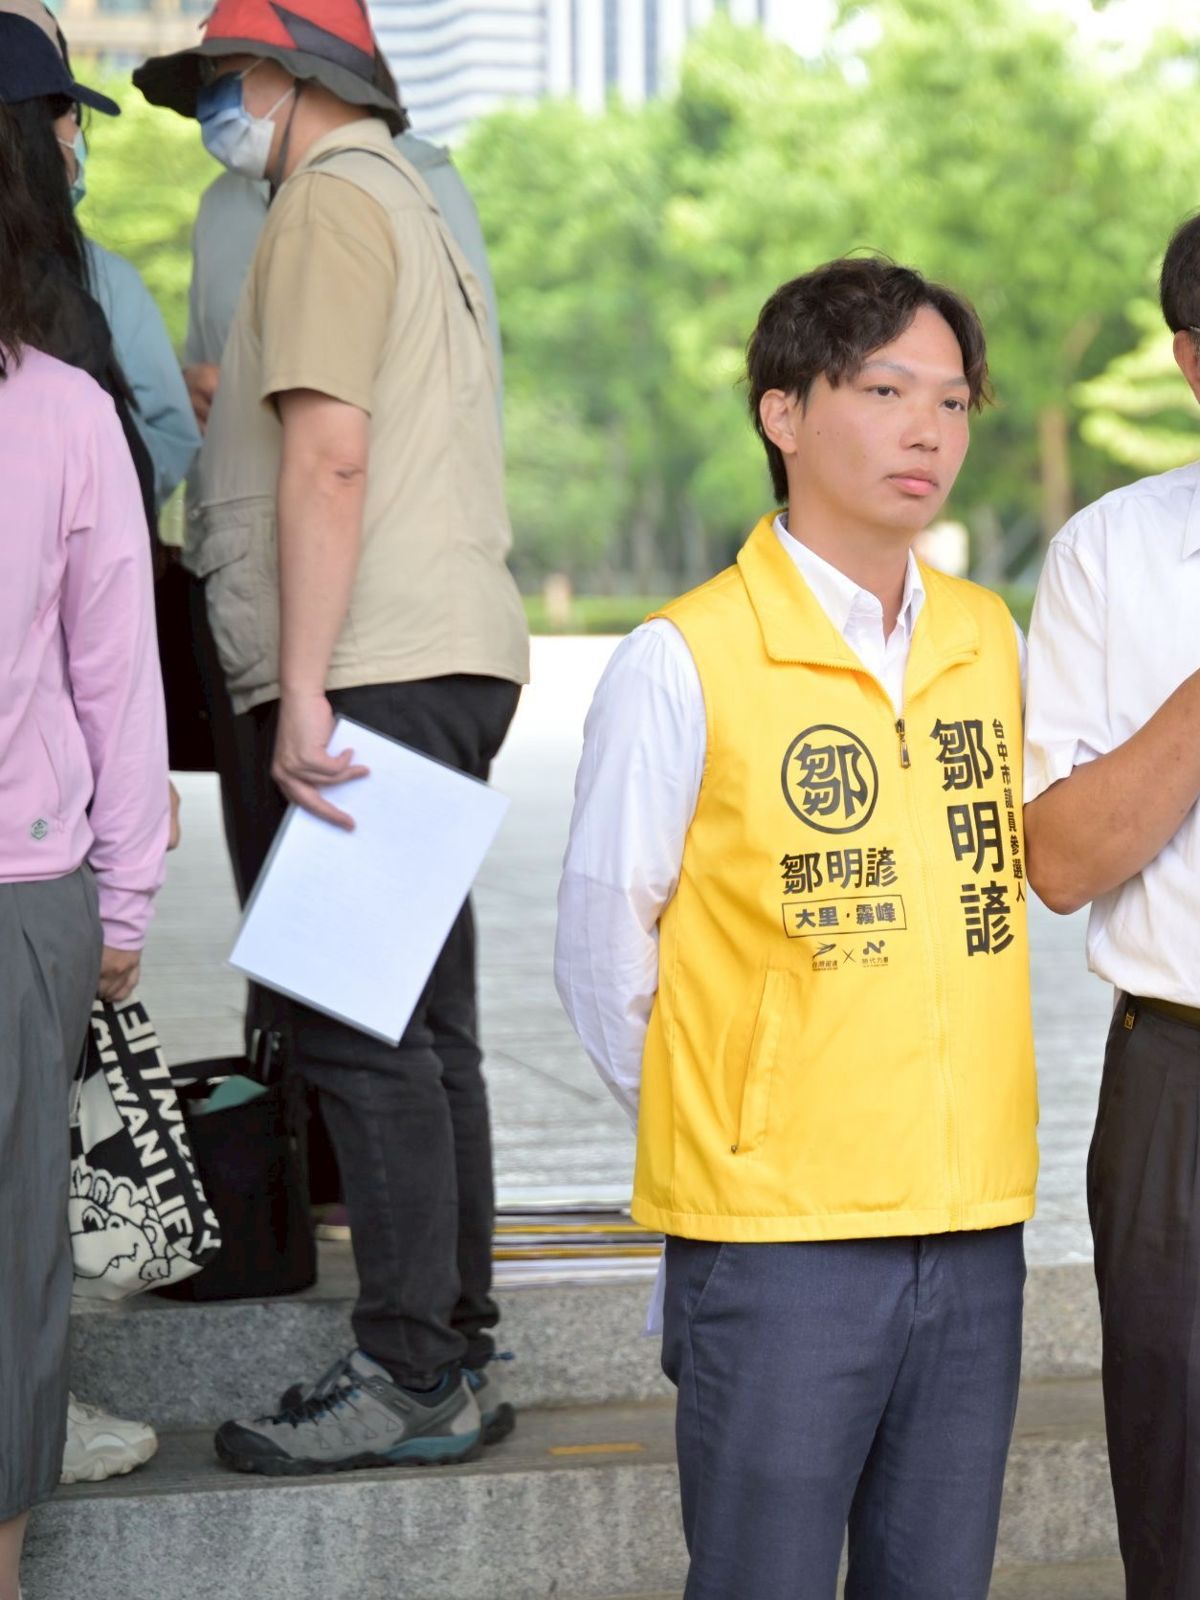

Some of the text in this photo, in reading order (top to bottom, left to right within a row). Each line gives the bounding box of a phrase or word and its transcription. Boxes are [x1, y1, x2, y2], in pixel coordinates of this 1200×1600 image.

[794, 742, 869, 819] 鄒
[779, 846, 898, 895] 鄒明諺
[929, 718, 1015, 957] 鄒明諺
